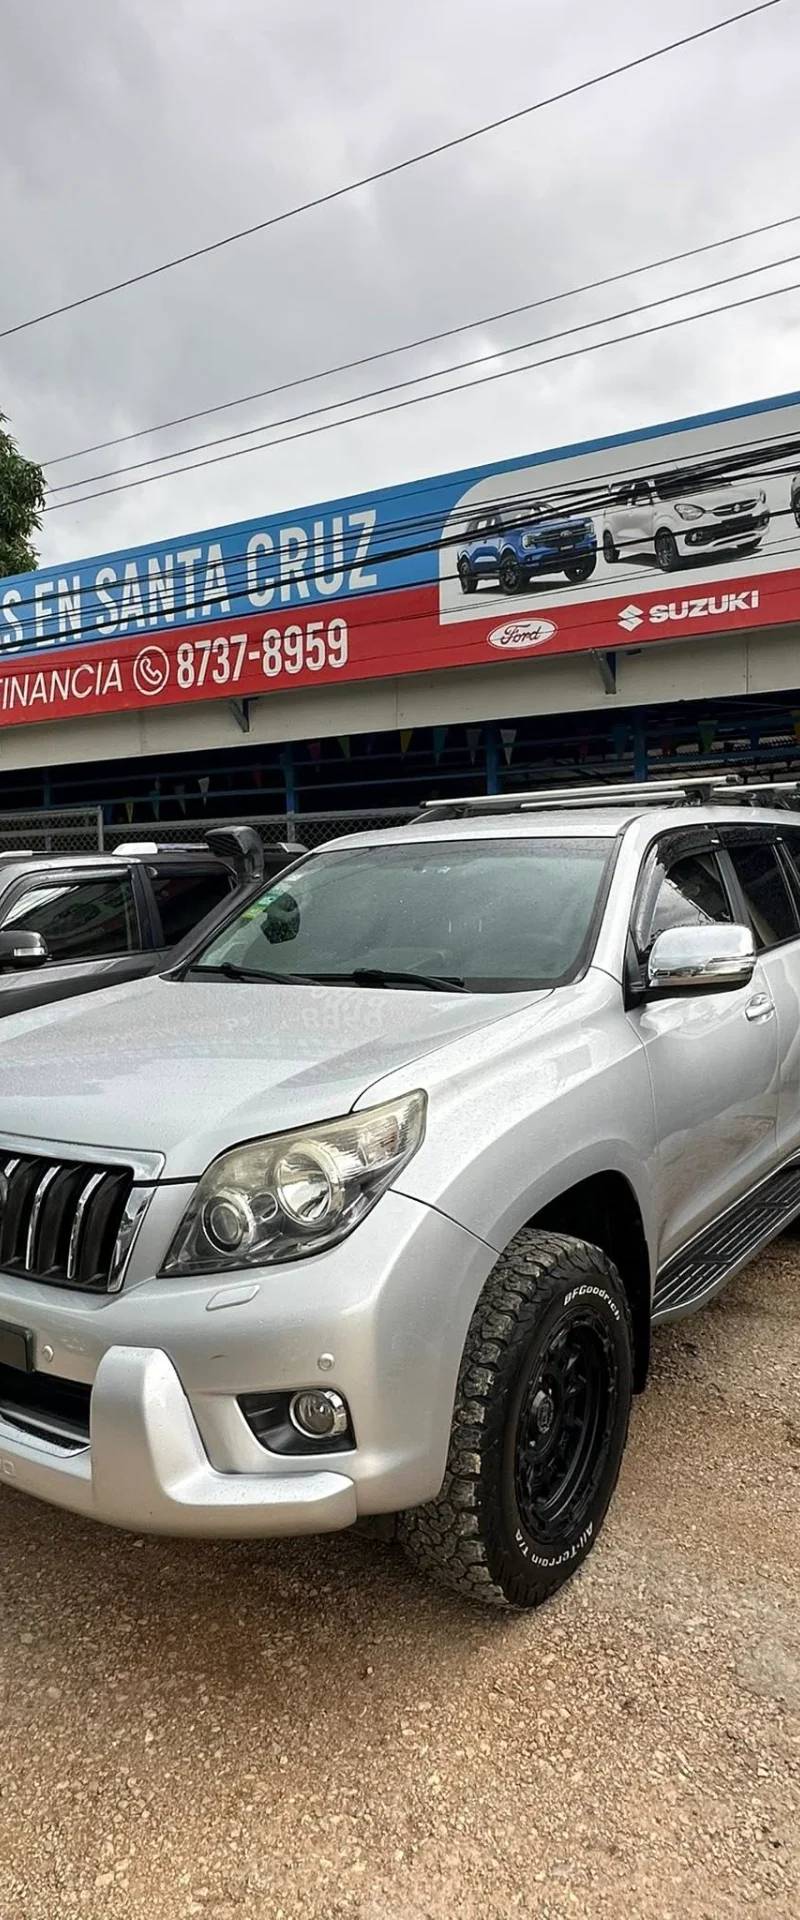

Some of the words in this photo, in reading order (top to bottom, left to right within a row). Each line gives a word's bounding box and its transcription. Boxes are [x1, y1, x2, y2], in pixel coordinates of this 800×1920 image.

[0, 589, 23, 653] S
[34, 575, 81, 647] EN
[95, 543, 231, 634] SANTA
[246, 509, 377, 607] CRUZ
[648, 590, 759, 624] SUZUKI
[500, 623, 542, 645] Ford
[0, 659, 123, 710] INANCIA
[176, 618, 348, 689] 8737-8959
[564, 1284, 621, 1321] BFGoodrich
[531, 1521, 593, 1567] All-Terrain
